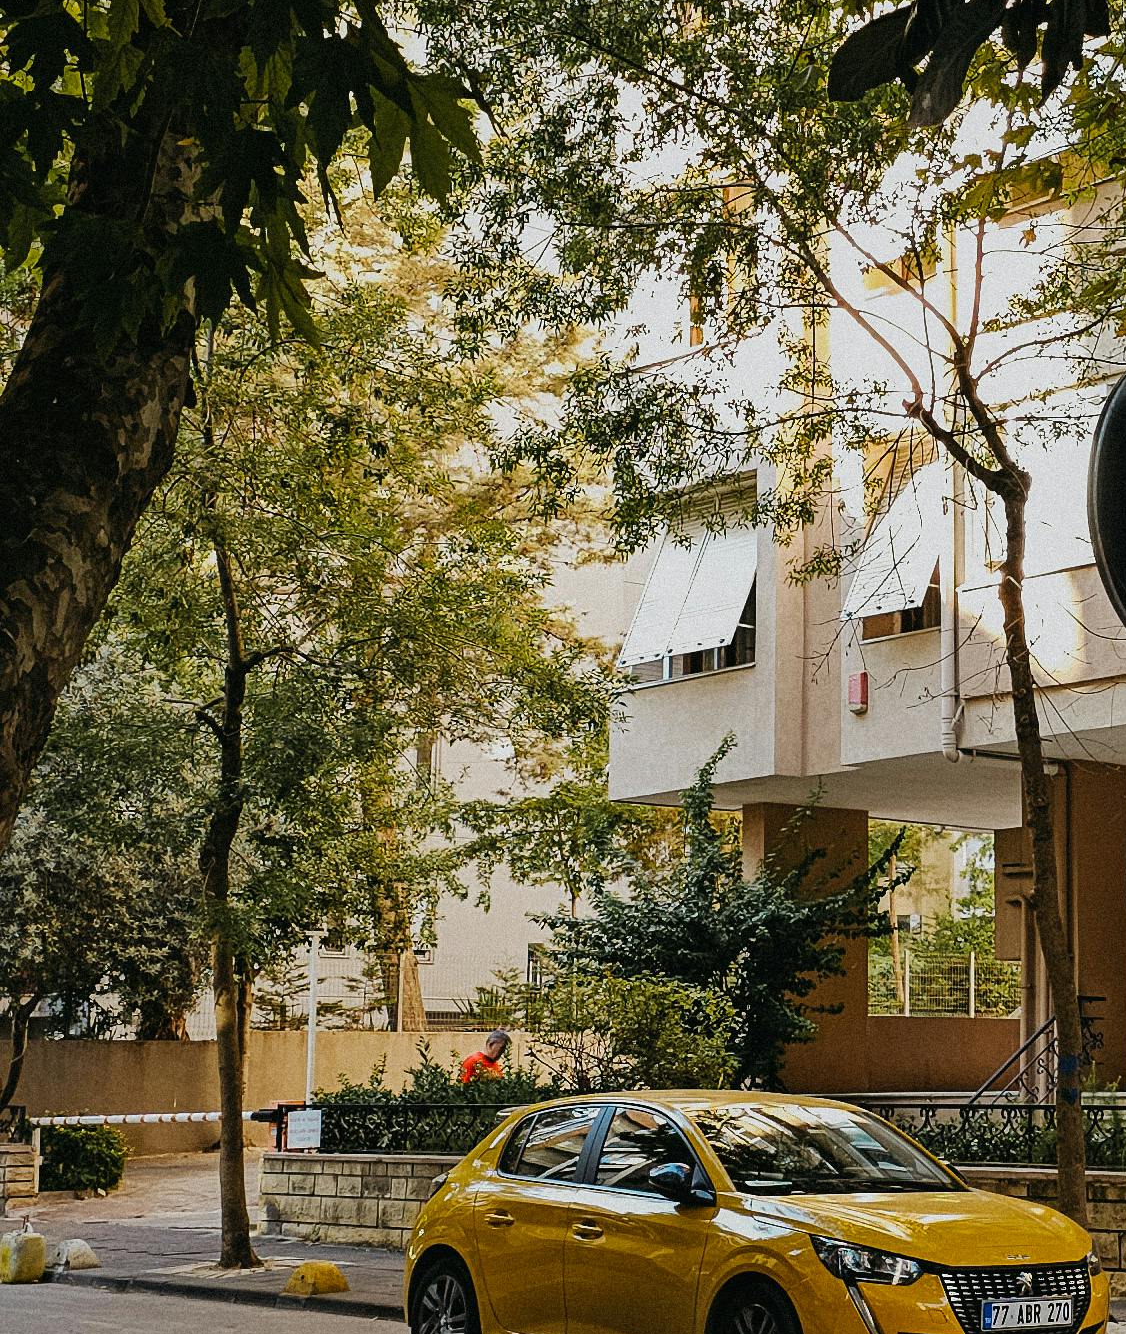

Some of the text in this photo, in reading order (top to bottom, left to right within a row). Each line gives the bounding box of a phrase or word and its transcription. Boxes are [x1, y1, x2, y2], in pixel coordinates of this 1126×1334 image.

[993, 1302, 1070, 1325] 77 ABR 270
